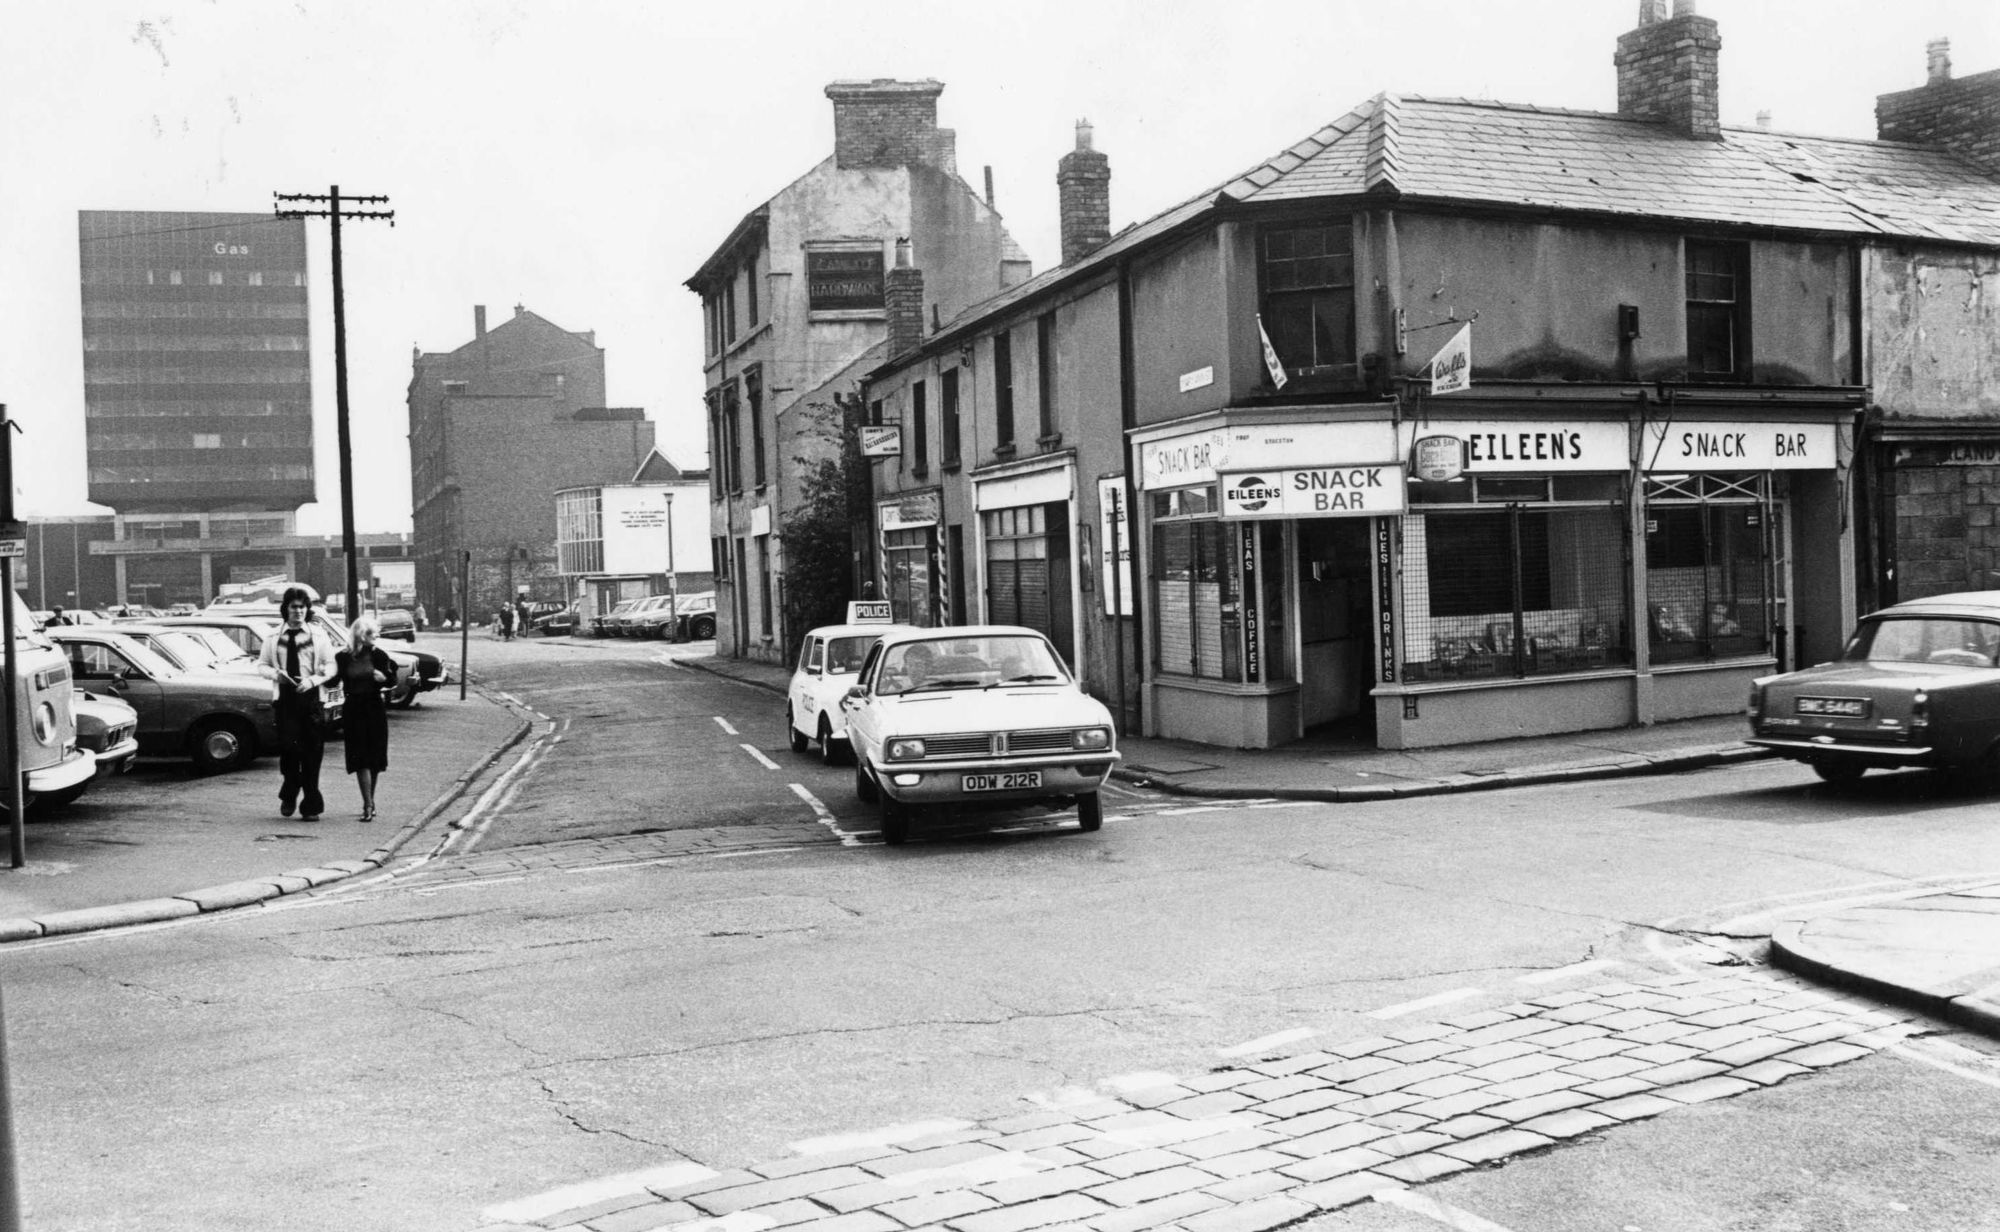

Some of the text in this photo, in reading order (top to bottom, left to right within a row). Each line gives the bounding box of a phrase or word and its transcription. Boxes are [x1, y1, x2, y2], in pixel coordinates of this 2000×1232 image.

[215, 242, 248, 254] Gas
[1470, 428, 1582, 460] EILEEN'S
[1682, 432, 1807, 457] SNACK BAR
[1159, 447, 1190, 475] SNACK
[1193, 443, 1212, 470] BAR
[1294, 468, 1382, 491] SNACK
[1315, 491, 1364, 511] BAR
[1244, 528, 1253, 570] TEAS
[1379, 519, 1388, 563] ICES
[857, 604, 889, 618] POLICE
[1247, 608, 1257, 674] COFFEE
[1383, 612, 1392, 681] DRINKS
[966, 773, 1039, 790] ODW 212R
